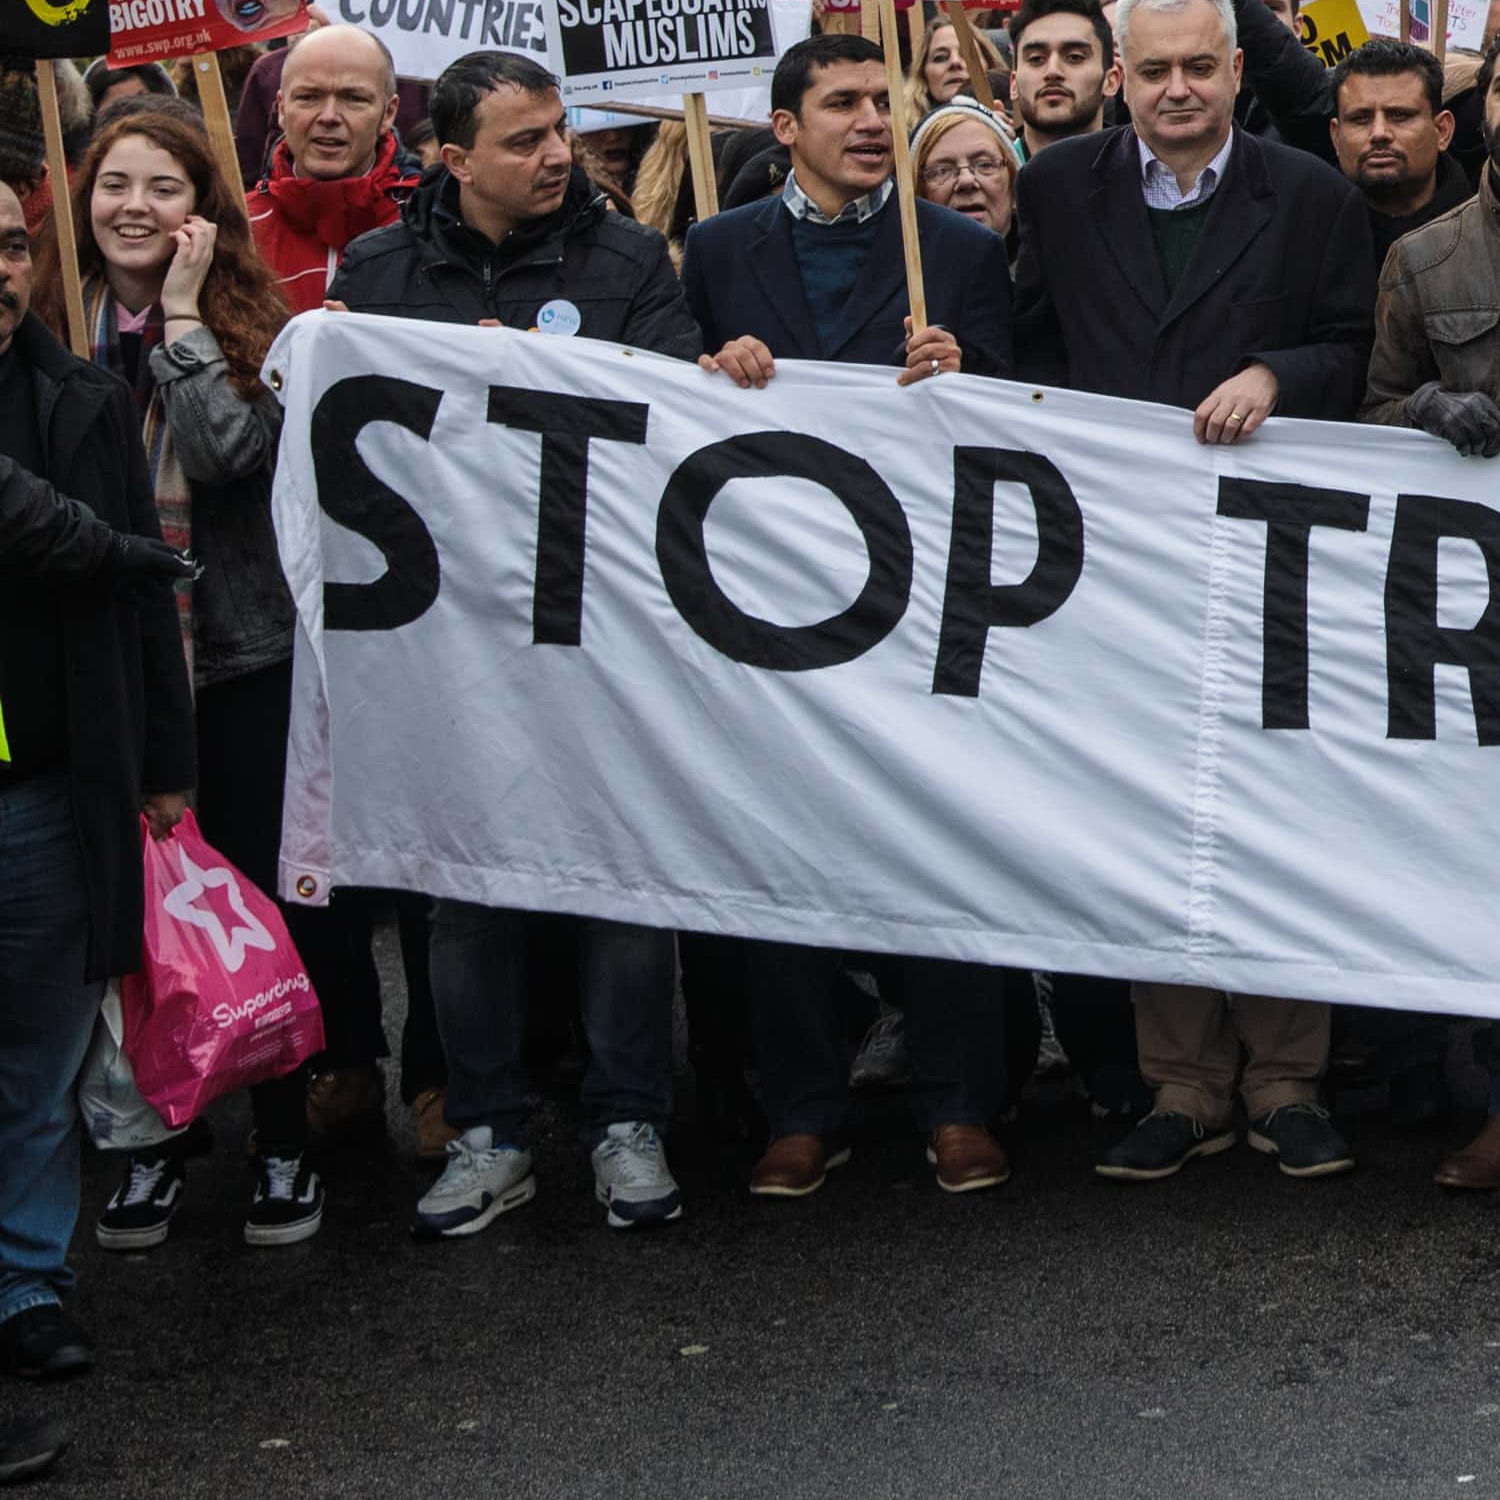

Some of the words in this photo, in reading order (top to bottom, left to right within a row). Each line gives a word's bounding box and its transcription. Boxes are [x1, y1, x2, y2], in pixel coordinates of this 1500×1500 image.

[115, 30, 211, 60] www.swp.org.uk
[603, 10, 755, 69] MUSLIMS
[310, 372, 1084, 699] STOP
